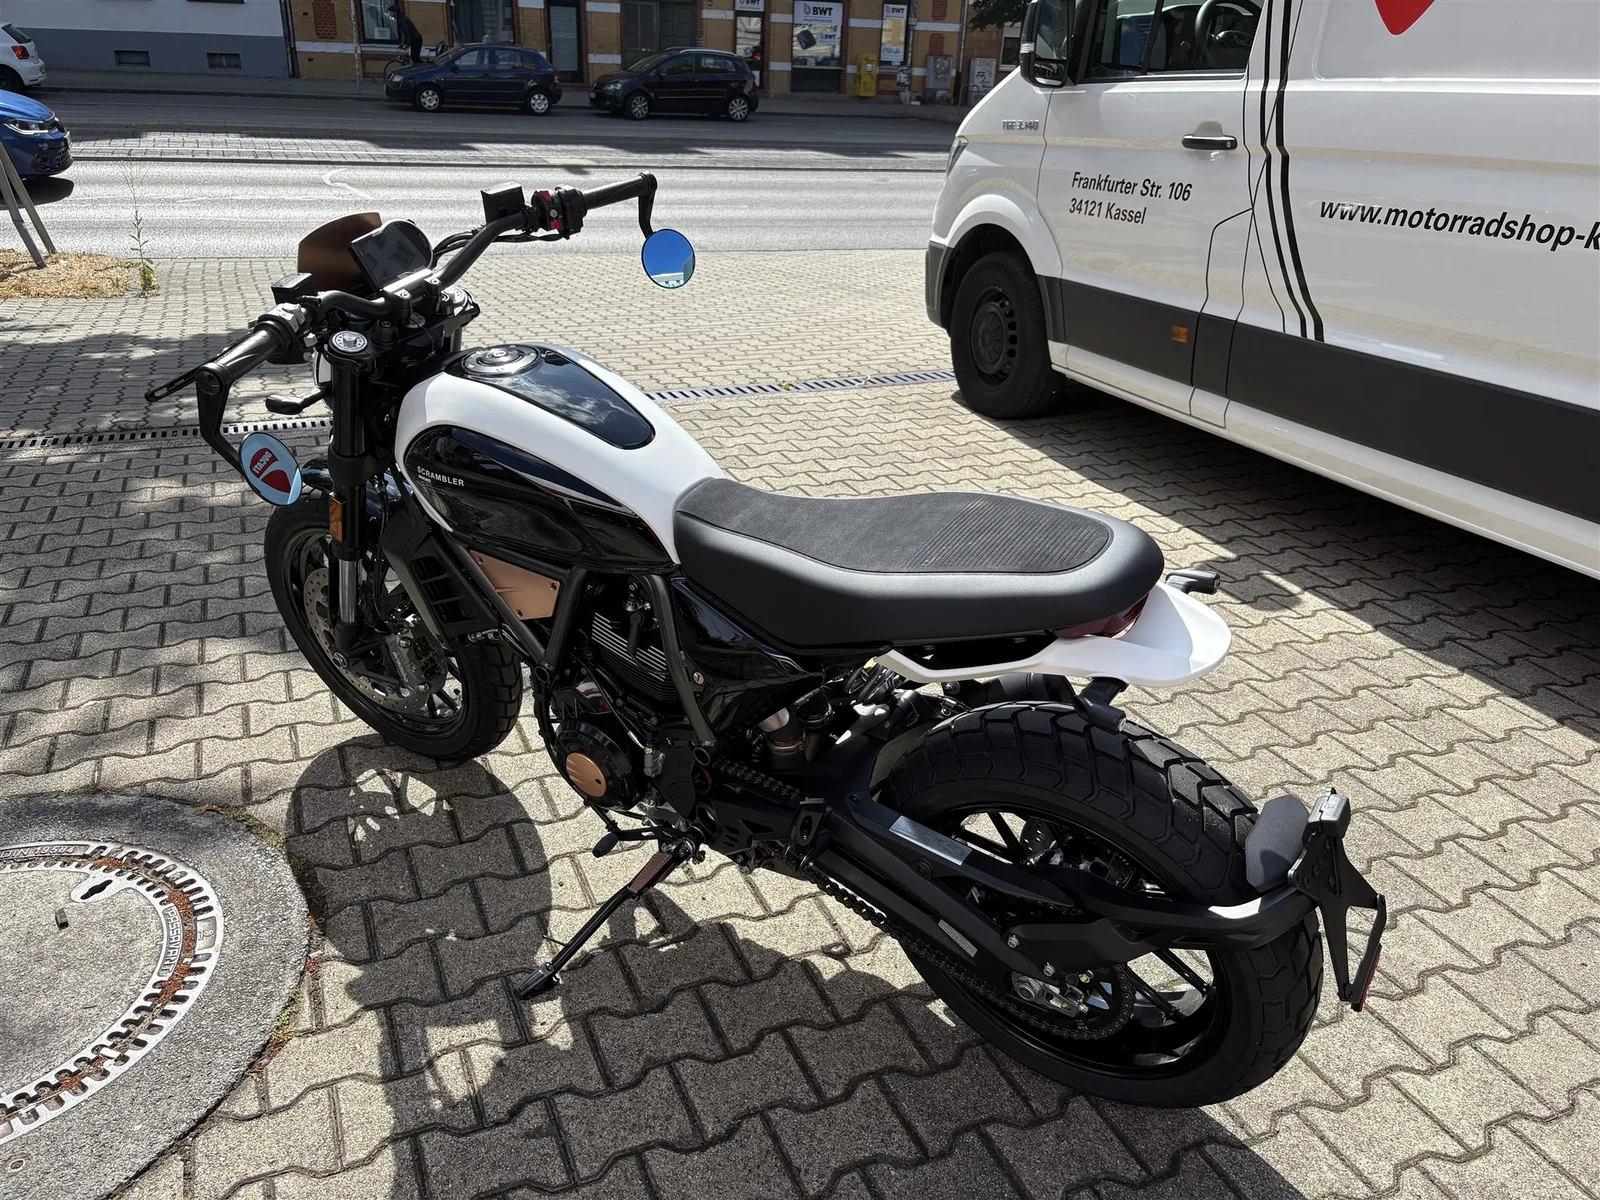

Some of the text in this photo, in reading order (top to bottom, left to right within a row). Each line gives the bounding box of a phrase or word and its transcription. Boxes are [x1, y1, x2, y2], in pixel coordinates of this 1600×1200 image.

[812, 6, 833, 16] BWT
[1071, 171, 1193, 201] Frankfurter Str. 106
[1069, 197, 1147, 225] 34121 Kassel
[417, 465, 465, 487] SCRAMBLER
[162, 909, 181, 973] PASSAVANT
